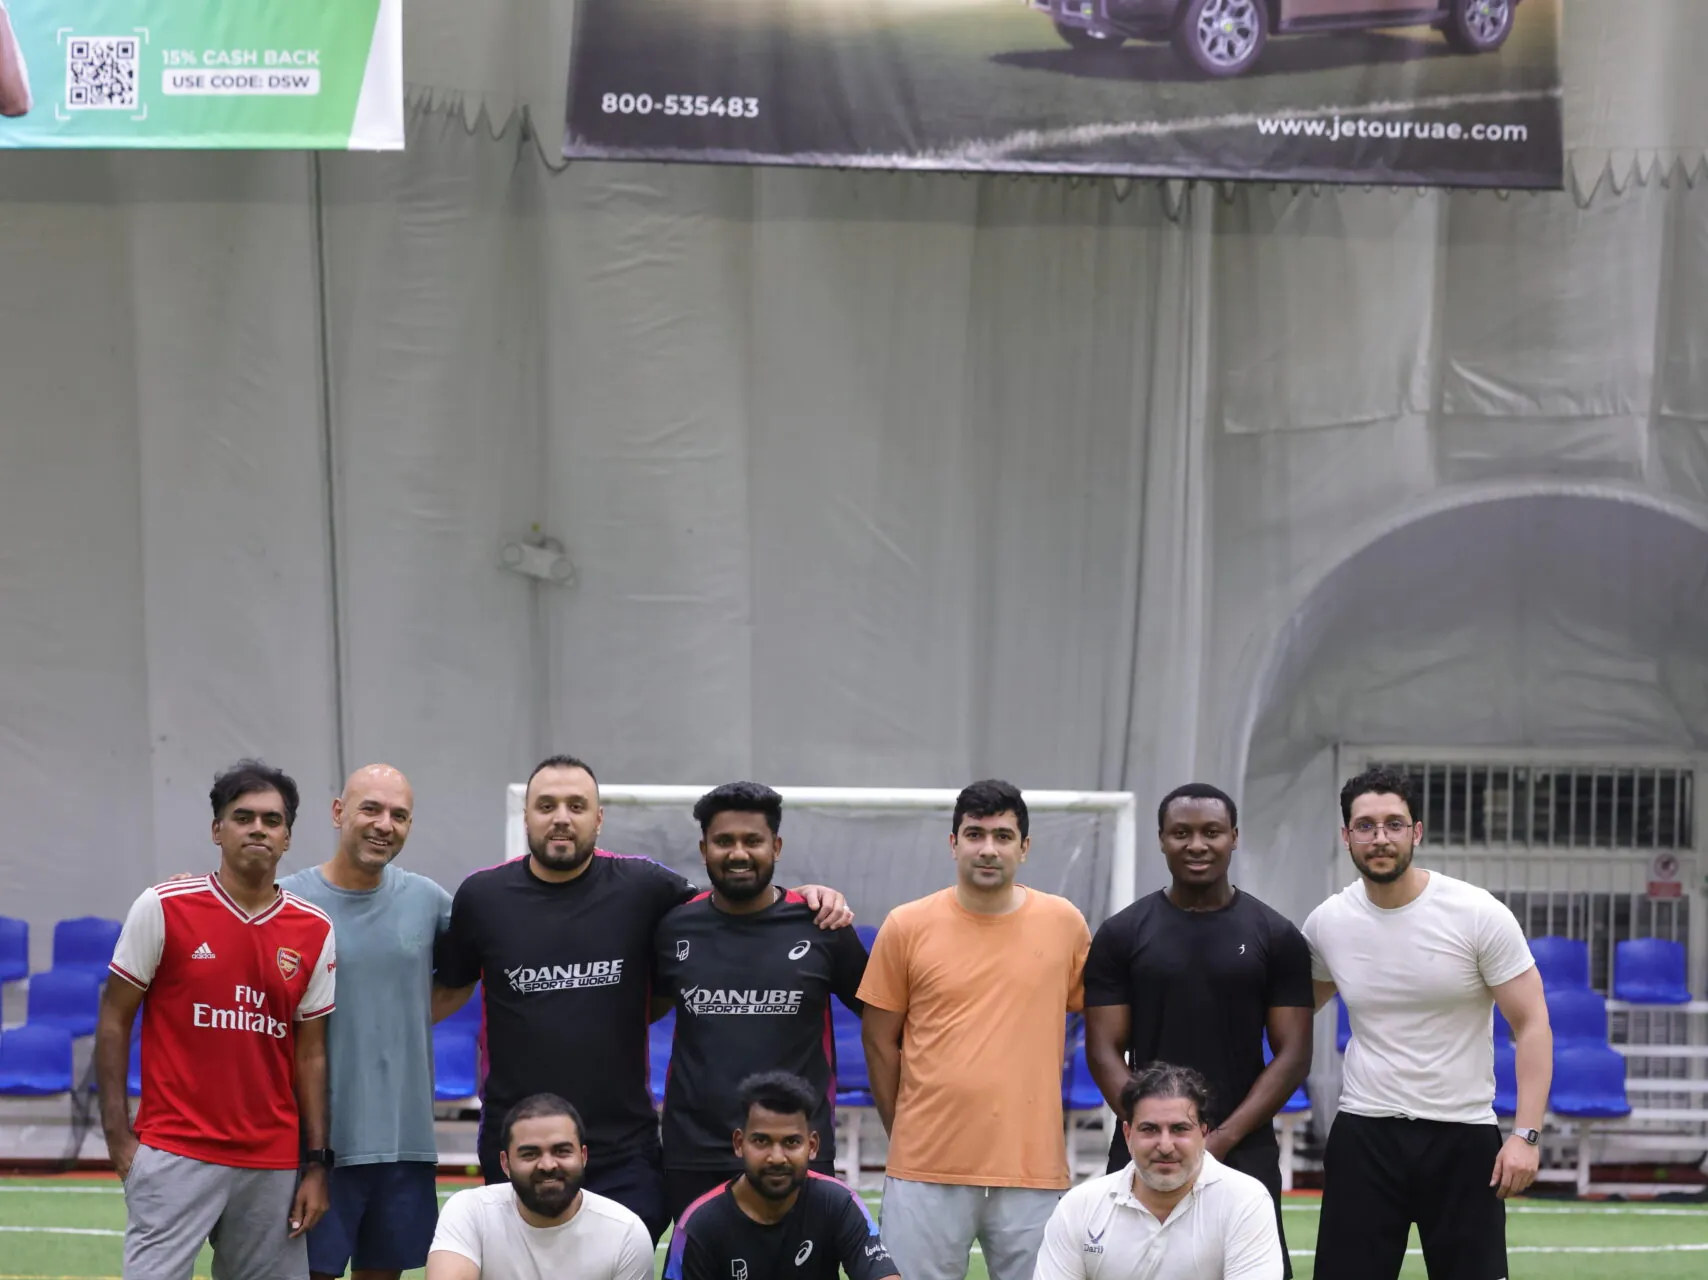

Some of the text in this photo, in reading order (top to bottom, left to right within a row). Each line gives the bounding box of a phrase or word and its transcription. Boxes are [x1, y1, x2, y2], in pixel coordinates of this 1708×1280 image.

[162, 49, 321, 66] 15% CASH BACK
[172, 75, 310, 89] USE CODE: DSW
[601, 92, 760, 118] 800-535483
[1256, 115, 1528, 143] www.jetouruae.com
[519, 959, 624, 983] DANUBE
[523, 974, 621, 991] SPORTS WORLD
[234, 985, 266, 1009] Fly
[692, 988, 804, 1005] DANUBE
[697, 1004, 799, 1014] SPORTS WORLD
